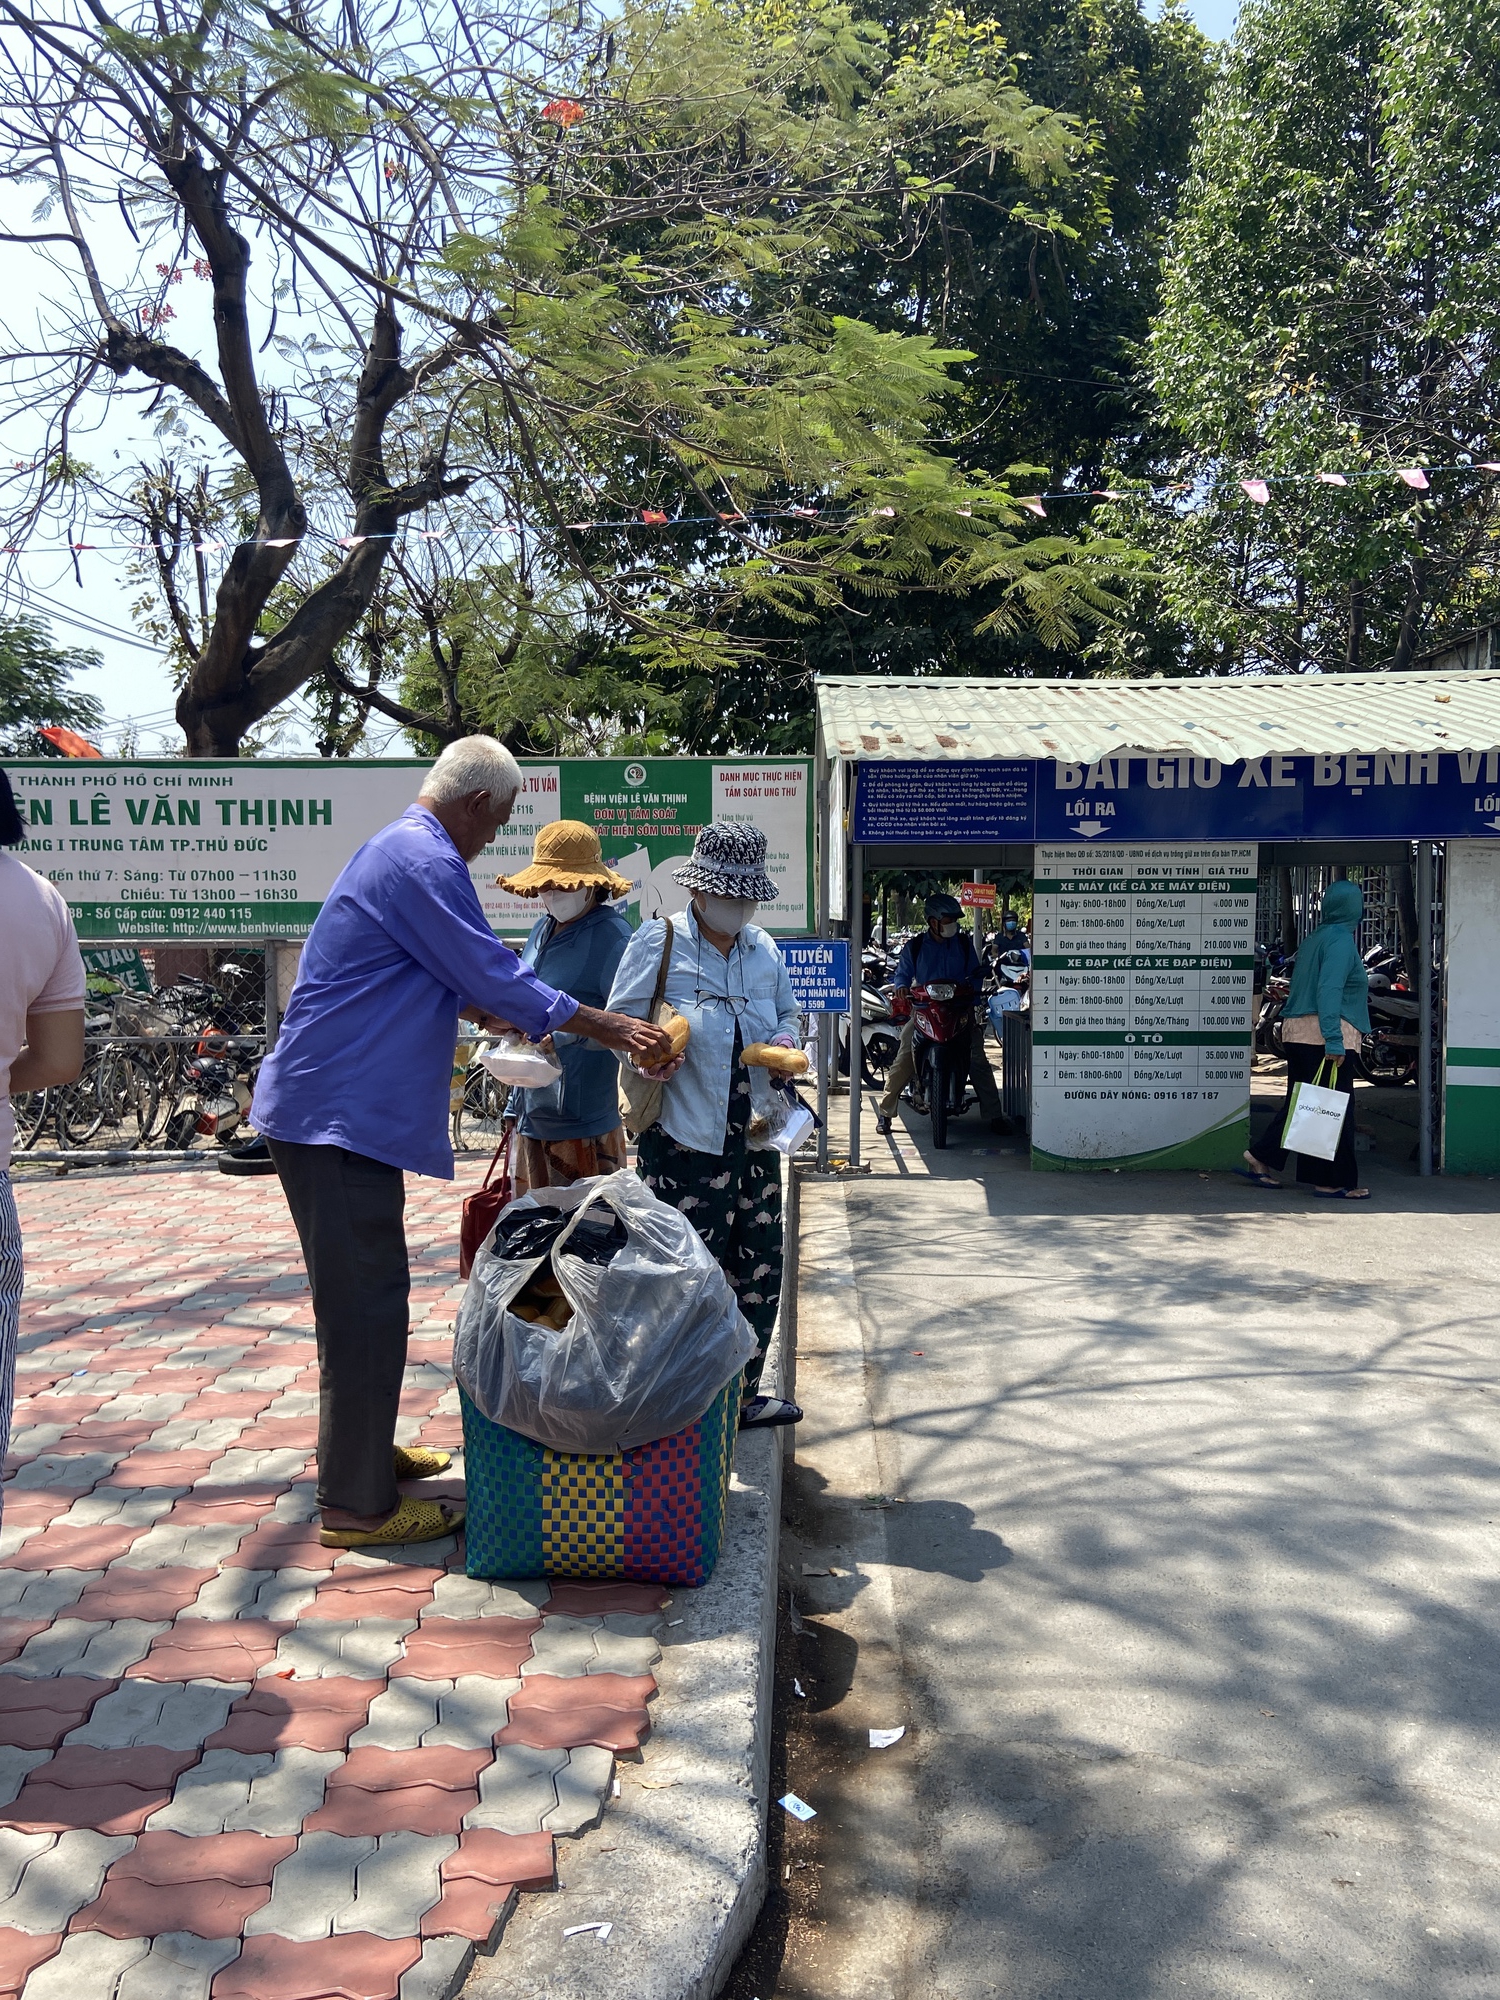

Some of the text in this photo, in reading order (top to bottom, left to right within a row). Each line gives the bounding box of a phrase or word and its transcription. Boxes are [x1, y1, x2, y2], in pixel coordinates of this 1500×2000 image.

[1237, 756, 1296, 788] XE
[1458, 752, 1499, 784] VI
[18, 772, 234, 787] THÀNH PHỐ HỒ CHÍ MINH
[530, 776, 540, 792] TƯ
[542, 772, 557, 792] VẤN
[720, 770, 802, 784] DANH MỤC THỰC HIỆN
[725, 786, 797, 797] TẦM SOÁT UNG THƯ
[584, 792, 687, 805] BỆNH VIỆN LÊ VĂN THỊNH
[69, 792, 111, 826] LÊ
[125, 794, 200, 826] VĂN
[215, 799, 333, 832] THỊNH
[517, 804, 533, 814] F116
[1065, 797, 1116, 816] LỐI RA
[594, 806, 677, 822] ĐƠN VỊ TẦM SOÁT
[502, 823, 533, 838] BỆNH THEO
[612, 823, 634, 838] HIỆN
[637, 823, 658, 836] SỚM
[661, 825, 680, 836] UNG
[56, 838, 65, 852] I
[69, 839, 124, 852] TRUNG
[130, 836, 164, 852] TÂM
[170, 836, 228, 852] TP.THỦ
[234, 837, 268, 852] ĐỨC
[496, 844, 508, 857] VIỆN
[510, 844, 517, 856] LÊ
[518, 844, 530, 856] VĂN
[49, 868, 296, 884] đến thứ 7: Sáng: Từ 07h00 11h30
[1072, 866, 1096, 876] THỜI
[1099, 868, 1123, 876] GIAN
[1137, 867, 1160, 876] ĐƠN
[1162, 868, 1172, 877] VỊ
[1176, 866, 1200, 875] TÍNH
[1208, 866, 1225, 875] GIÁ
[1060, 883, 1074, 891] XE
[1079, 881, 1104, 891] MÁY
[1131, 881, 1147, 891] CẢ
[1151, 882, 1165, 890] XE
[1169, 880, 1194, 890] MÁY
[1198, 880, 1230, 892] ĐIỆN)
[121, 887, 298, 901] Chiều: Từ 13h00 16h30
[1060, 899, 1081, 910] Ngày:
[1083, 899, 1126, 908] 6h00-18h00
[1136, 898, 1186, 909] Đồng/Xe/Lượt
[1234, 899, 1249, 907] VNĐ
[96, 906, 252, 920] Số Cấp cứu: 0912 440 115
[118, 921, 313, 936] Website: http://www.benhvienqua
[1044, 939, 1248, 950] 3 Đơn giá theo tháng Đồng/Xe/Tháng 210.000 VNĐ
[790, 944, 833, 964] TUYỂN
[1068, 958, 1082, 967] XE
[1085, 958, 1109, 969] ĐẠP
[1136, 957, 1151, 967] CẢ
[1155, 958, 1169, 966] XE
[1173, 958, 1197, 968] ĐẠP
[1200, 956, 1232, 969] ĐIỆN)
[804, 965, 816, 975] GIỮ
[818, 966, 827, 975] XE
[817, 978, 836, 986] 8.5TR
[792, 987, 845, 998] CHO NHÂN VIÊN
[808, 1000, 825, 1008] 5599
[1125, 1033, 1163, 1043] Ô TÔ
[1064, 1090, 1219, 1100] ĐƯỜNG DÂY NÓNG: 0916 187 187
